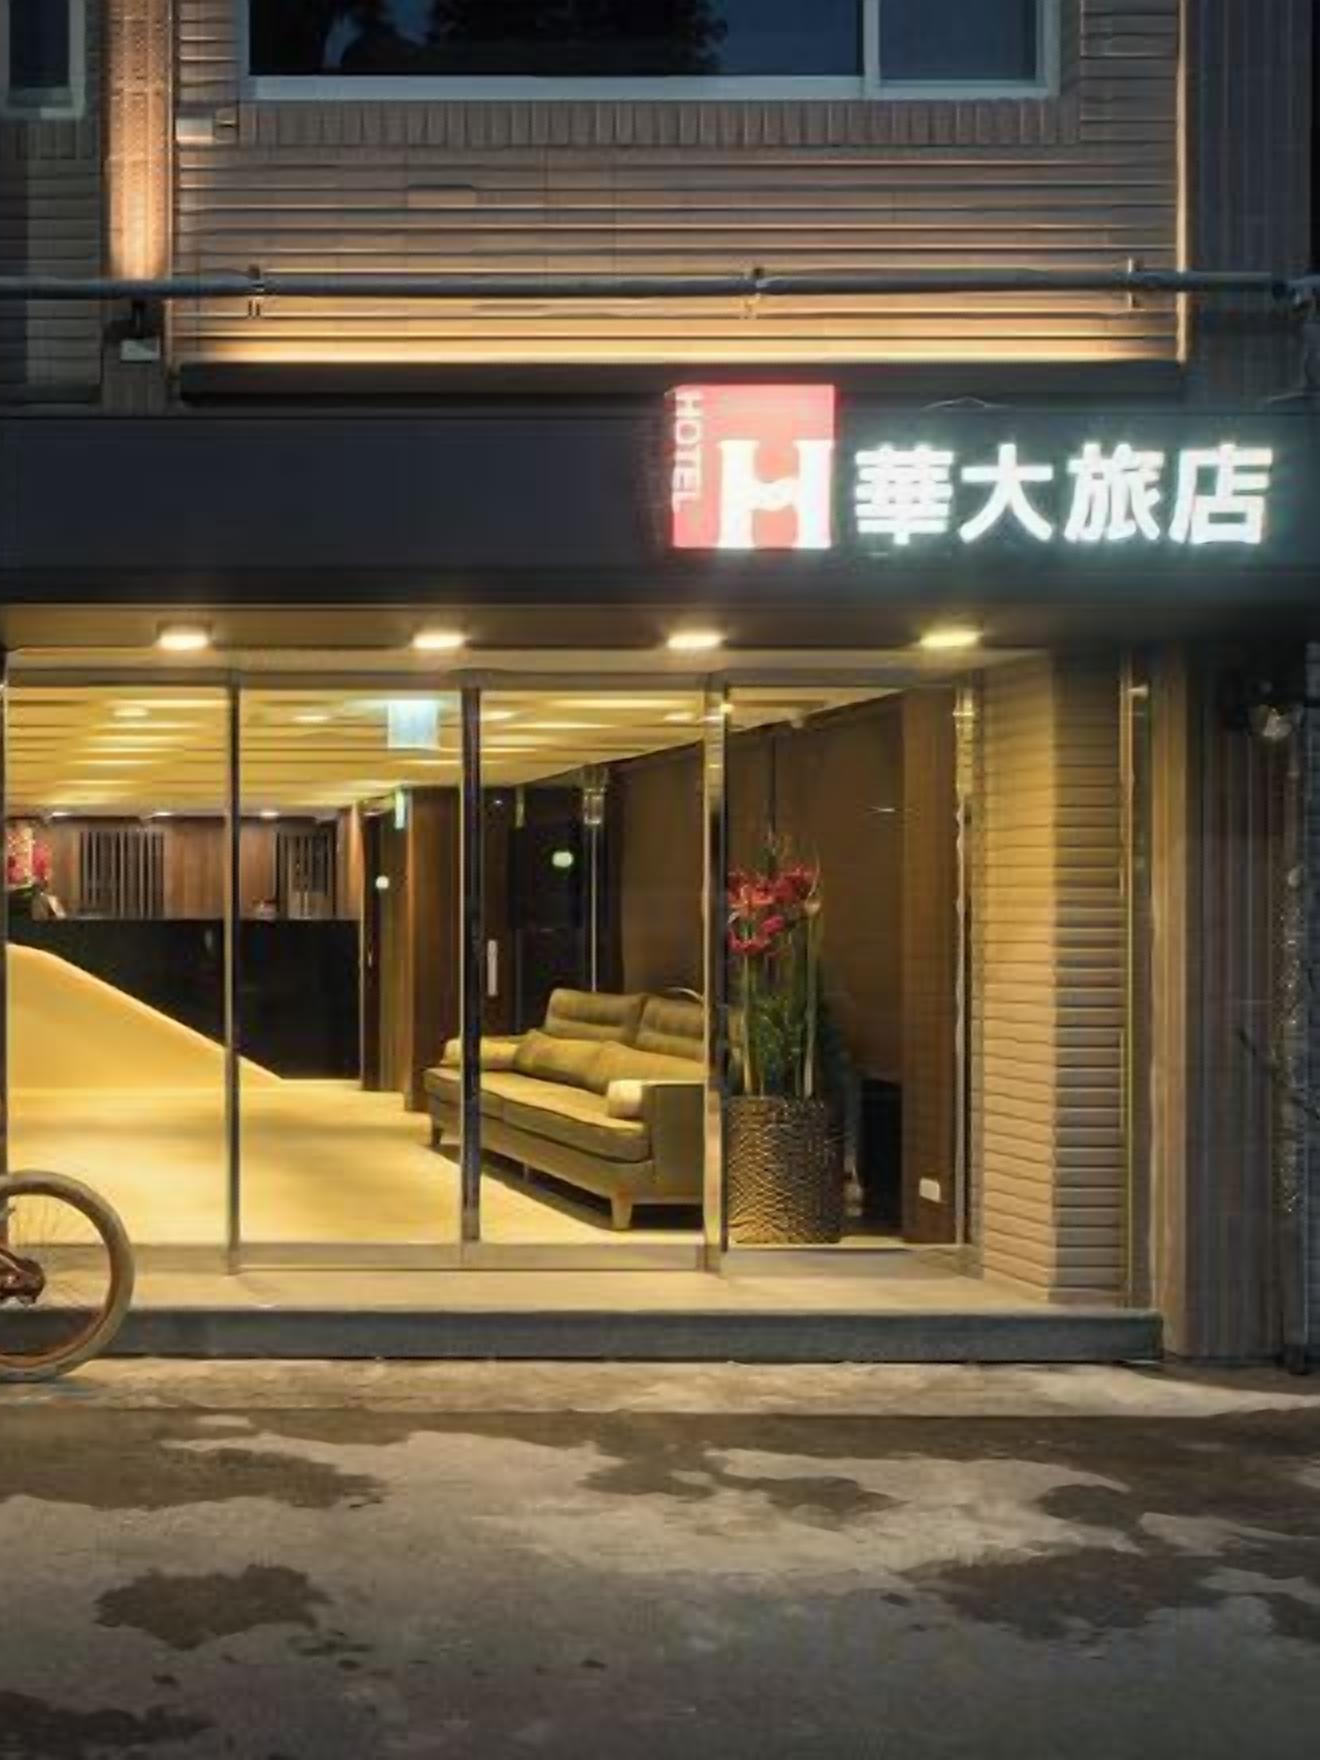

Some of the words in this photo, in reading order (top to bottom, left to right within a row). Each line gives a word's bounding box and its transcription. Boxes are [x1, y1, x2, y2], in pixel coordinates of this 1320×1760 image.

[671, 390, 703, 514] HOTEL
[717, 440, 834, 548] H
[854, 442, 1273, 545] 華大旅店
